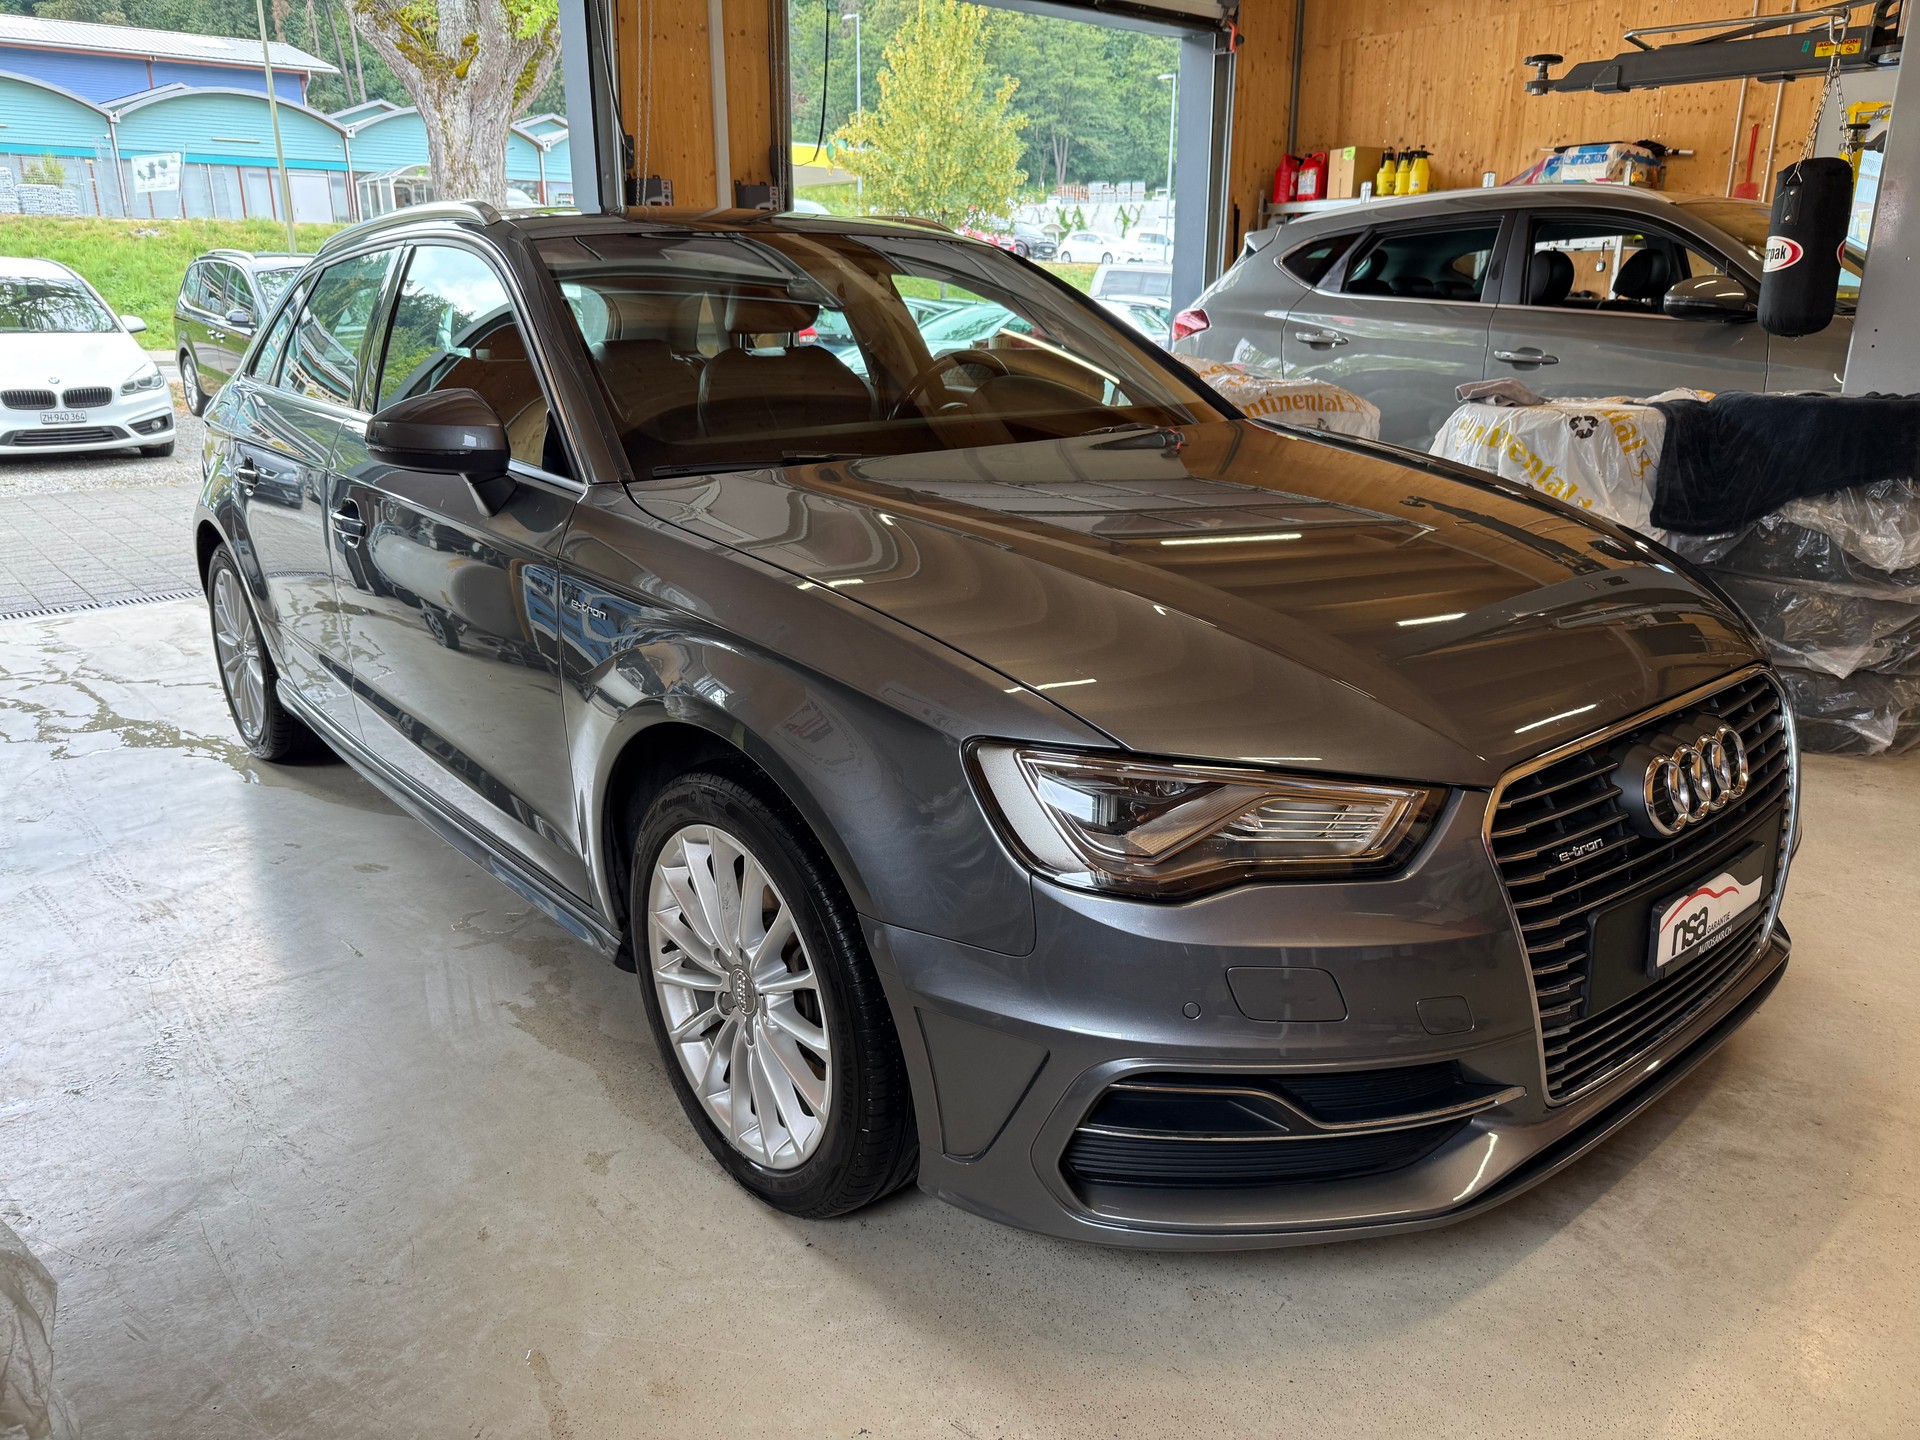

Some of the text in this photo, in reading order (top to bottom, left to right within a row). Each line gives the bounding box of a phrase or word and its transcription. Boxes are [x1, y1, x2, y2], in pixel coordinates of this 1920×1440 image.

[42, 412, 85, 422] ZH 940 364
[1234, 392, 1346, 418] ntinental
[571, 599, 606, 621] e-tron
[1559, 838, 1604, 862] e-tron
[1671, 906, 1731, 957] nsa GARANTIE
